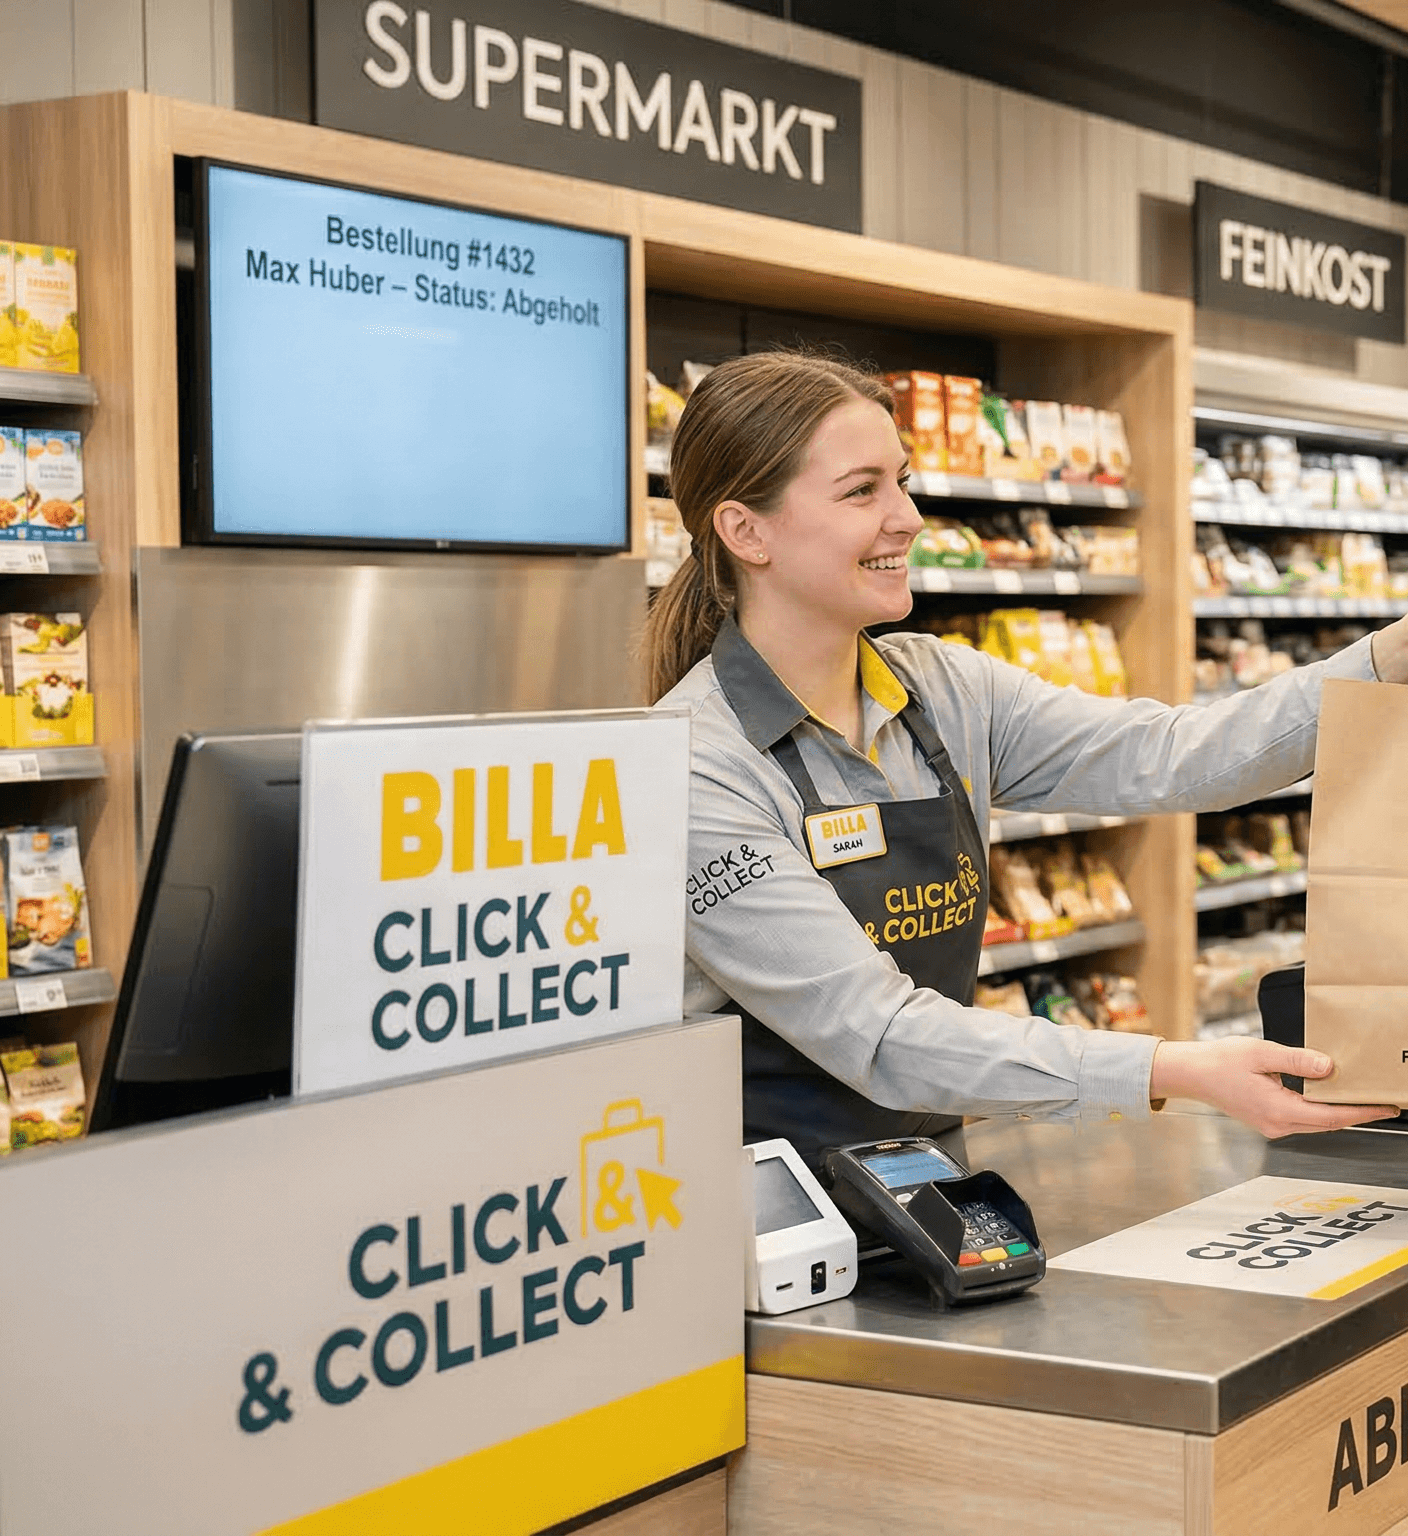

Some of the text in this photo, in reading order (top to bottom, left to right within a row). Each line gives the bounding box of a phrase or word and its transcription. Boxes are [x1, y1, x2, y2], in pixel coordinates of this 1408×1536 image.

[363, 0, 837, 185] SUPERMARKT
[326, 214, 536, 276] Bestellung #1432
[1219, 218, 1391, 312] FEINKOST
[245, 248, 300, 285] Max
[309, 256, 385, 297] Huber
[415, 273, 496, 313] Status:
[501, 288, 601, 328] Abgeholt
[380, 758, 627, 882] BILLA
[821, 813, 868, 840] BILLA
[833, 838, 863, 854] SARAH
[686, 844, 759, 895] CLICK &
[692, 855, 775, 915] COLLECT
[885, 879, 959, 914] CLICK
[374, 885, 600, 973] CLICK &
[864, 896, 977, 945] & COLLECT
[371, 953, 630, 1051] COLLECT
[349, 1176, 569, 1300] CLICK
[1186, 1211, 1324, 1261] CLICK
[238, 1241, 646, 1434] & COLLECT
